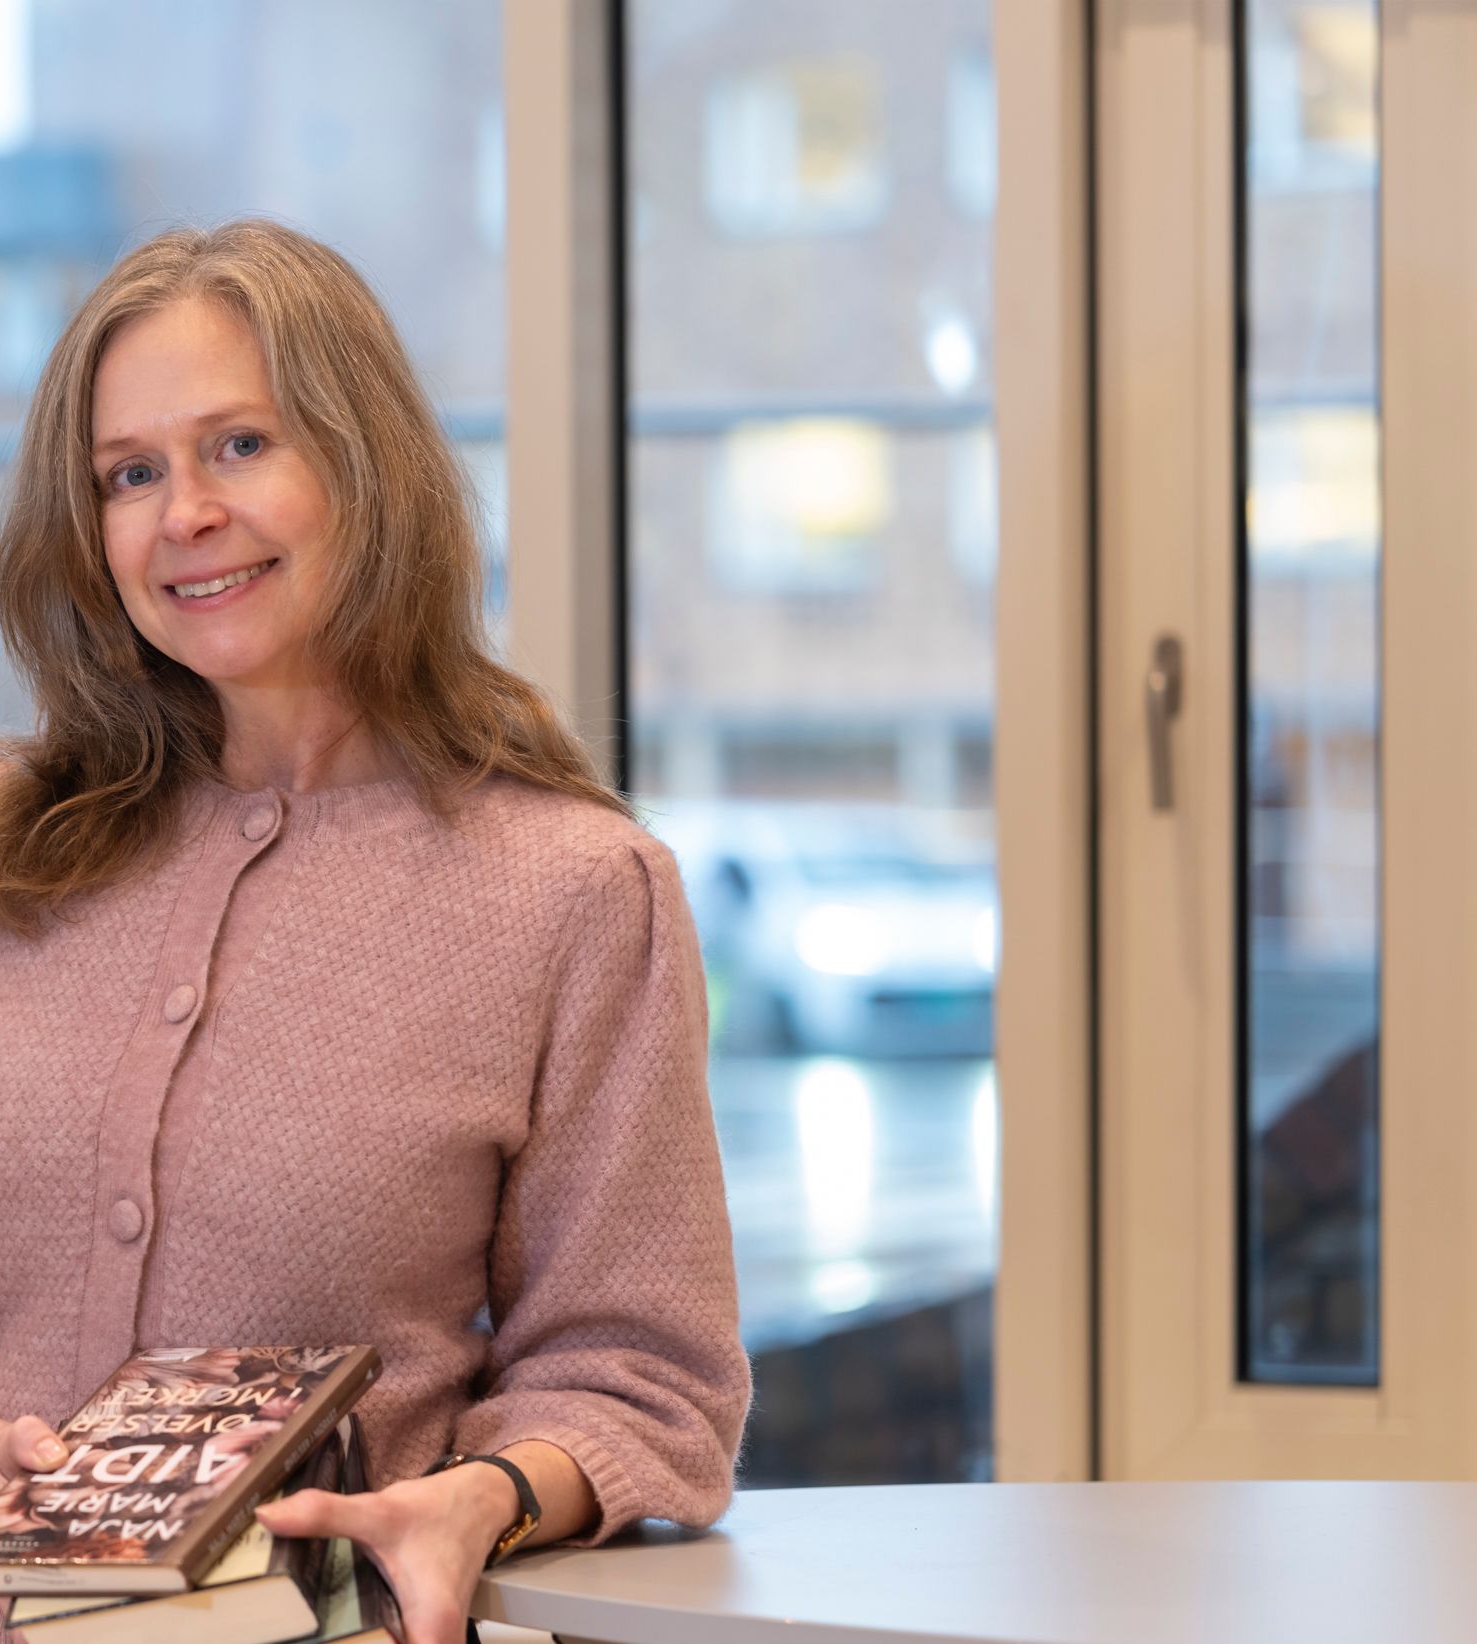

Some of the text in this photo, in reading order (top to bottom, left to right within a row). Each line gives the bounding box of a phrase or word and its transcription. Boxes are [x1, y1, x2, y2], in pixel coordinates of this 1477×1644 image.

[70, 1412, 253, 1434] ØVELSER
[31, 1443, 245, 1484] AIDT
[37, 1491, 176, 1514] MARIE
[67, 1518, 183, 1541] NAJA
